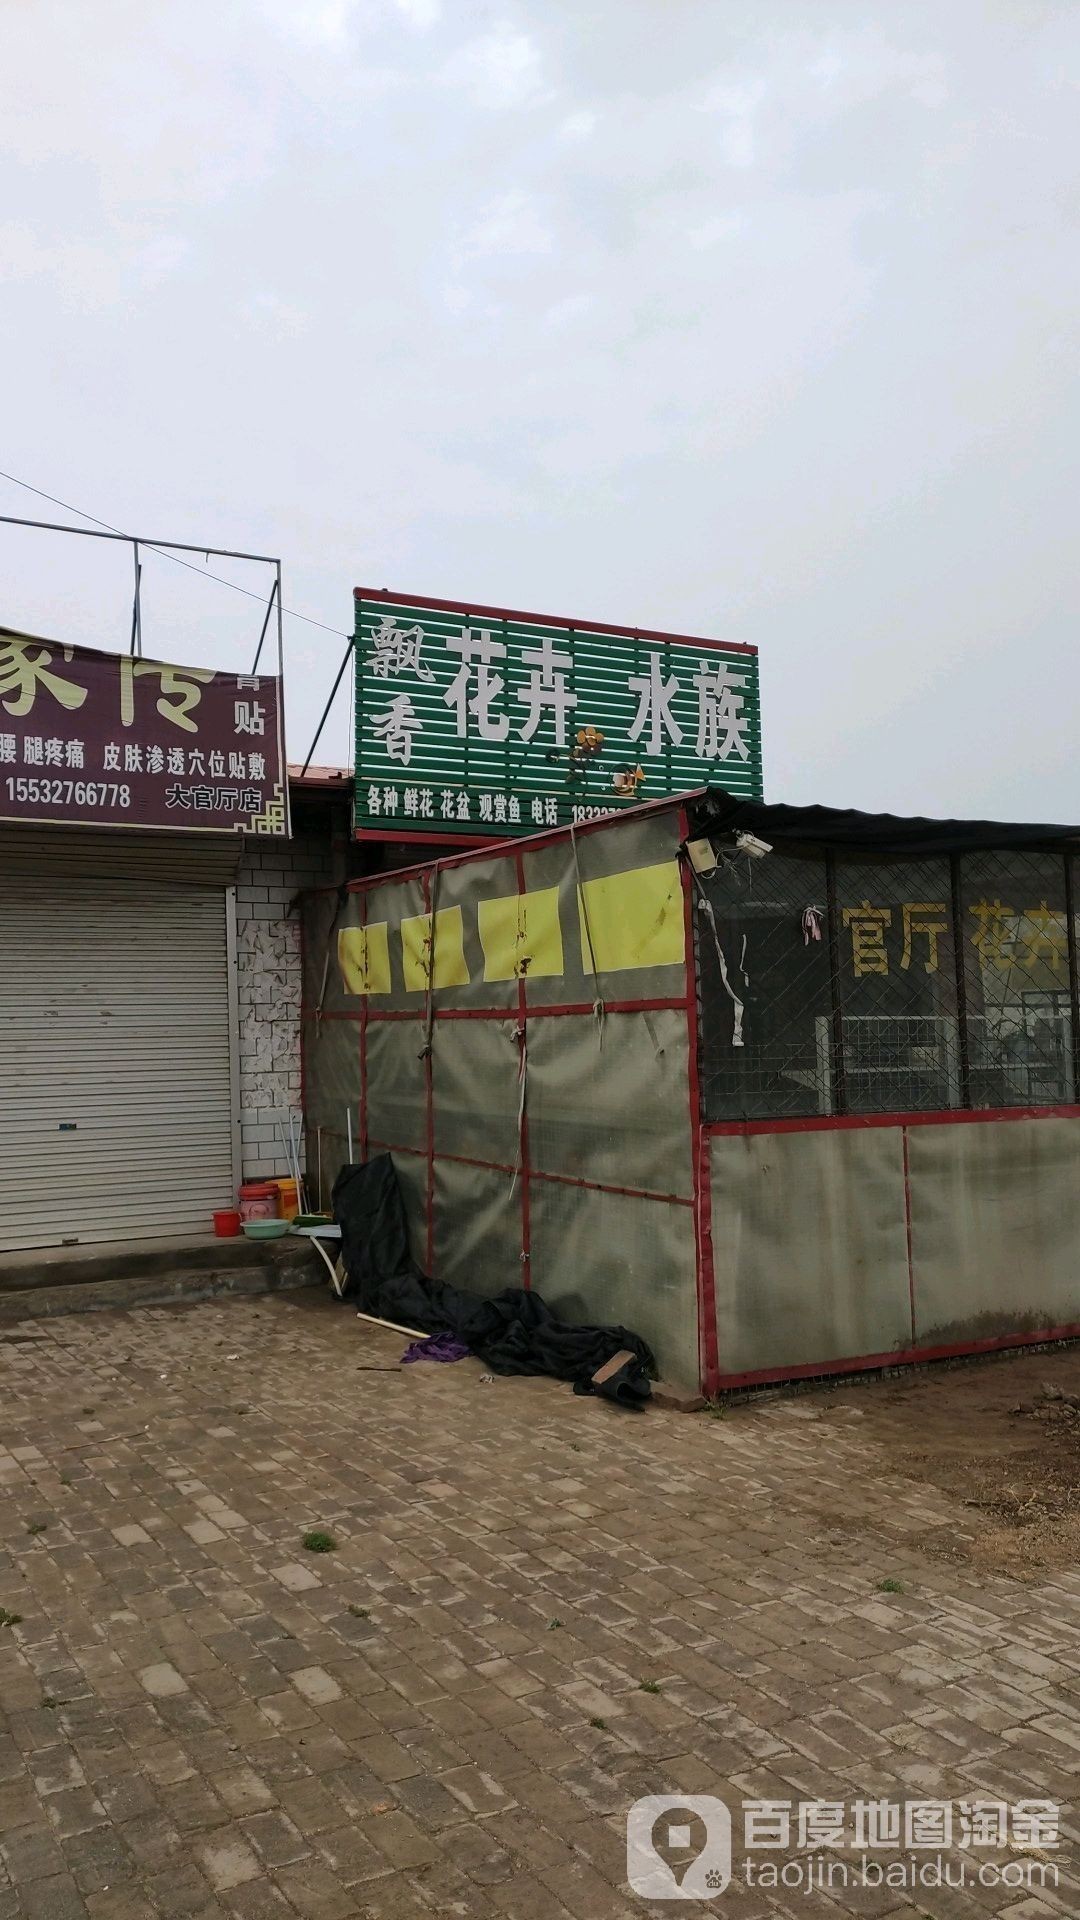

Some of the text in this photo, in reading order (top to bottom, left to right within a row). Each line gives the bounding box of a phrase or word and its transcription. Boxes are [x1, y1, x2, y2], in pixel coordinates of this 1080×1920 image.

[366, 617, 436, 766] 飘香
[443, 628, 752, 762] 花卉 水族
[5, 777, 262, 813] 15532766778 大官厅店
[103, 741, 266, 781] 皮肤渗透穴位贴敷
